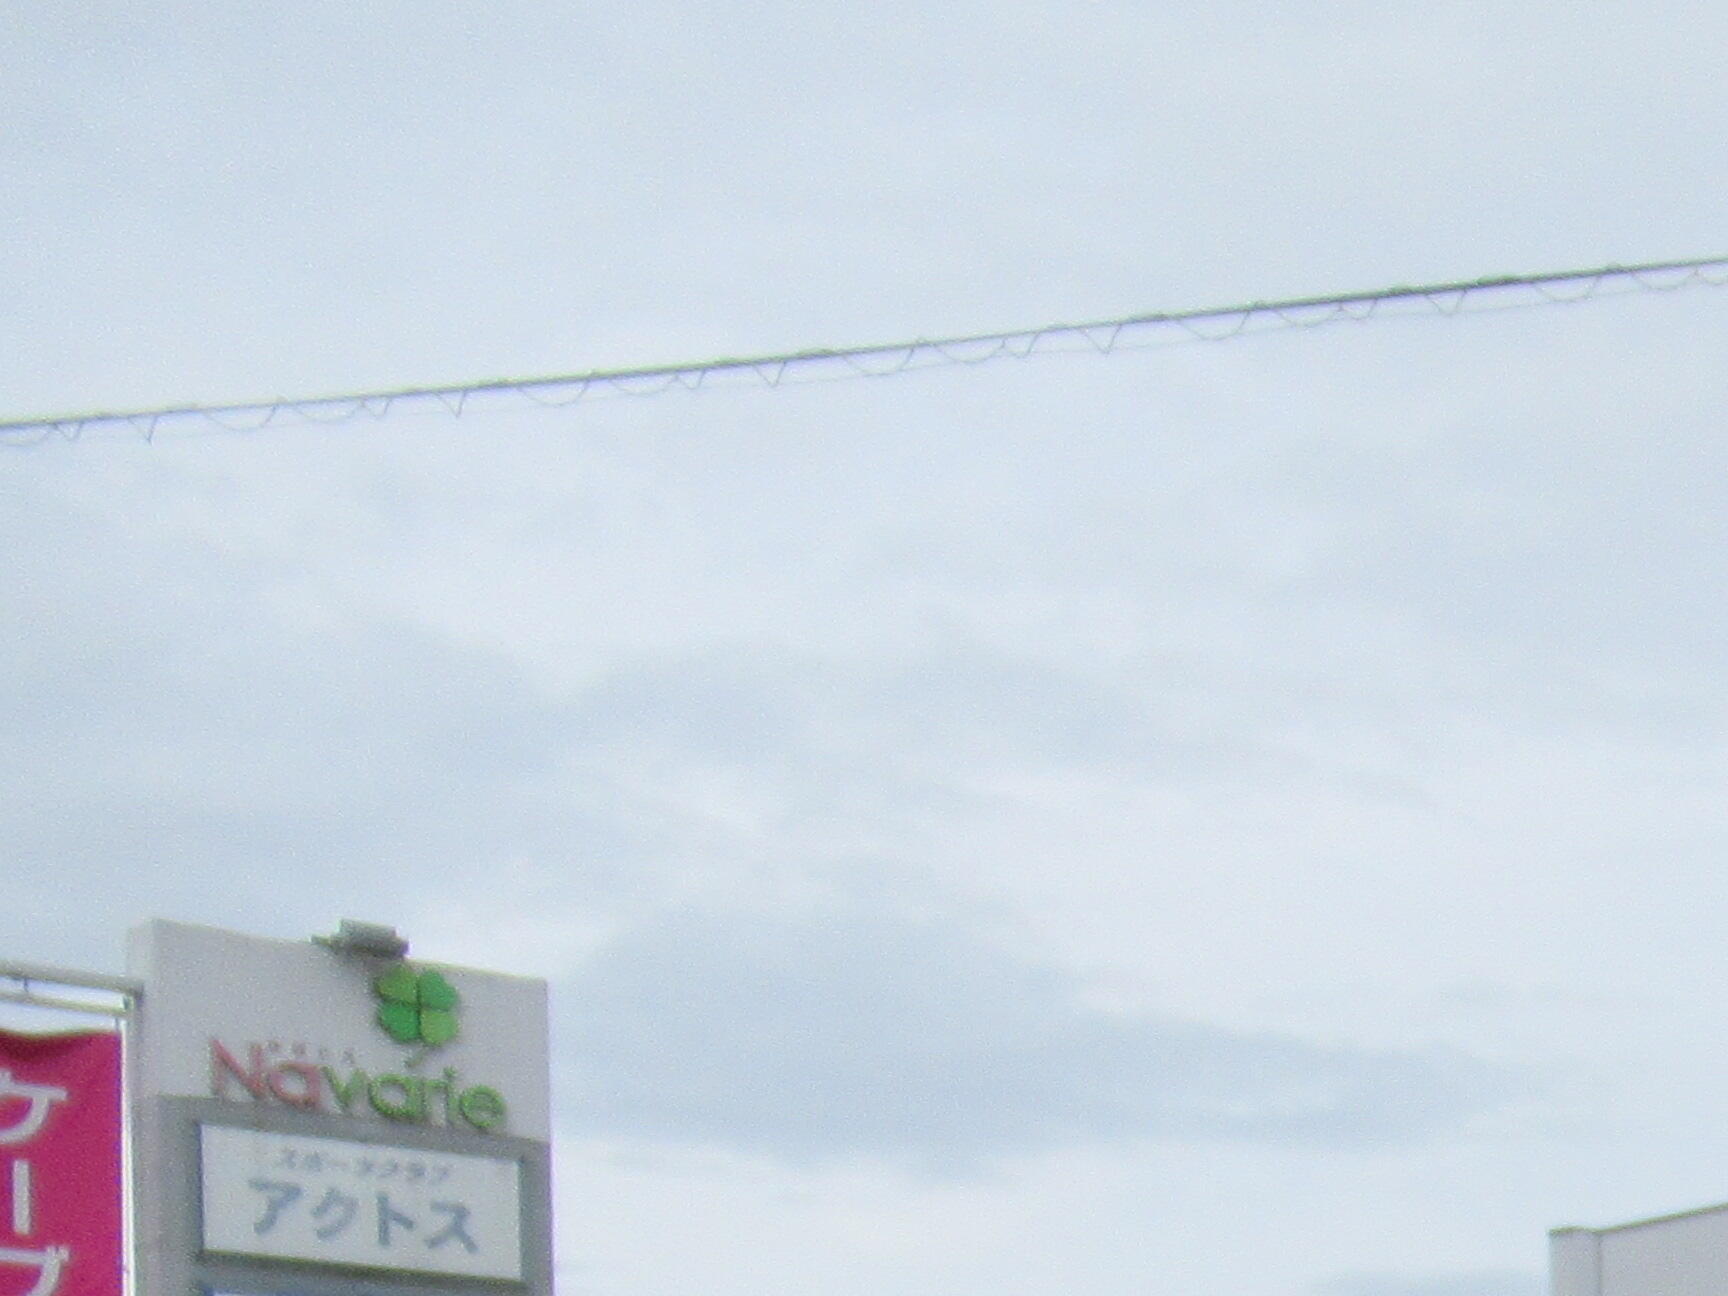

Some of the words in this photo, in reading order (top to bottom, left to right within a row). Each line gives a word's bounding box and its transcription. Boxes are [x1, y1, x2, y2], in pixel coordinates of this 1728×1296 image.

[209, 1037, 507, 1130] Navarie
[248, 1179, 480, 1254] アクトス
